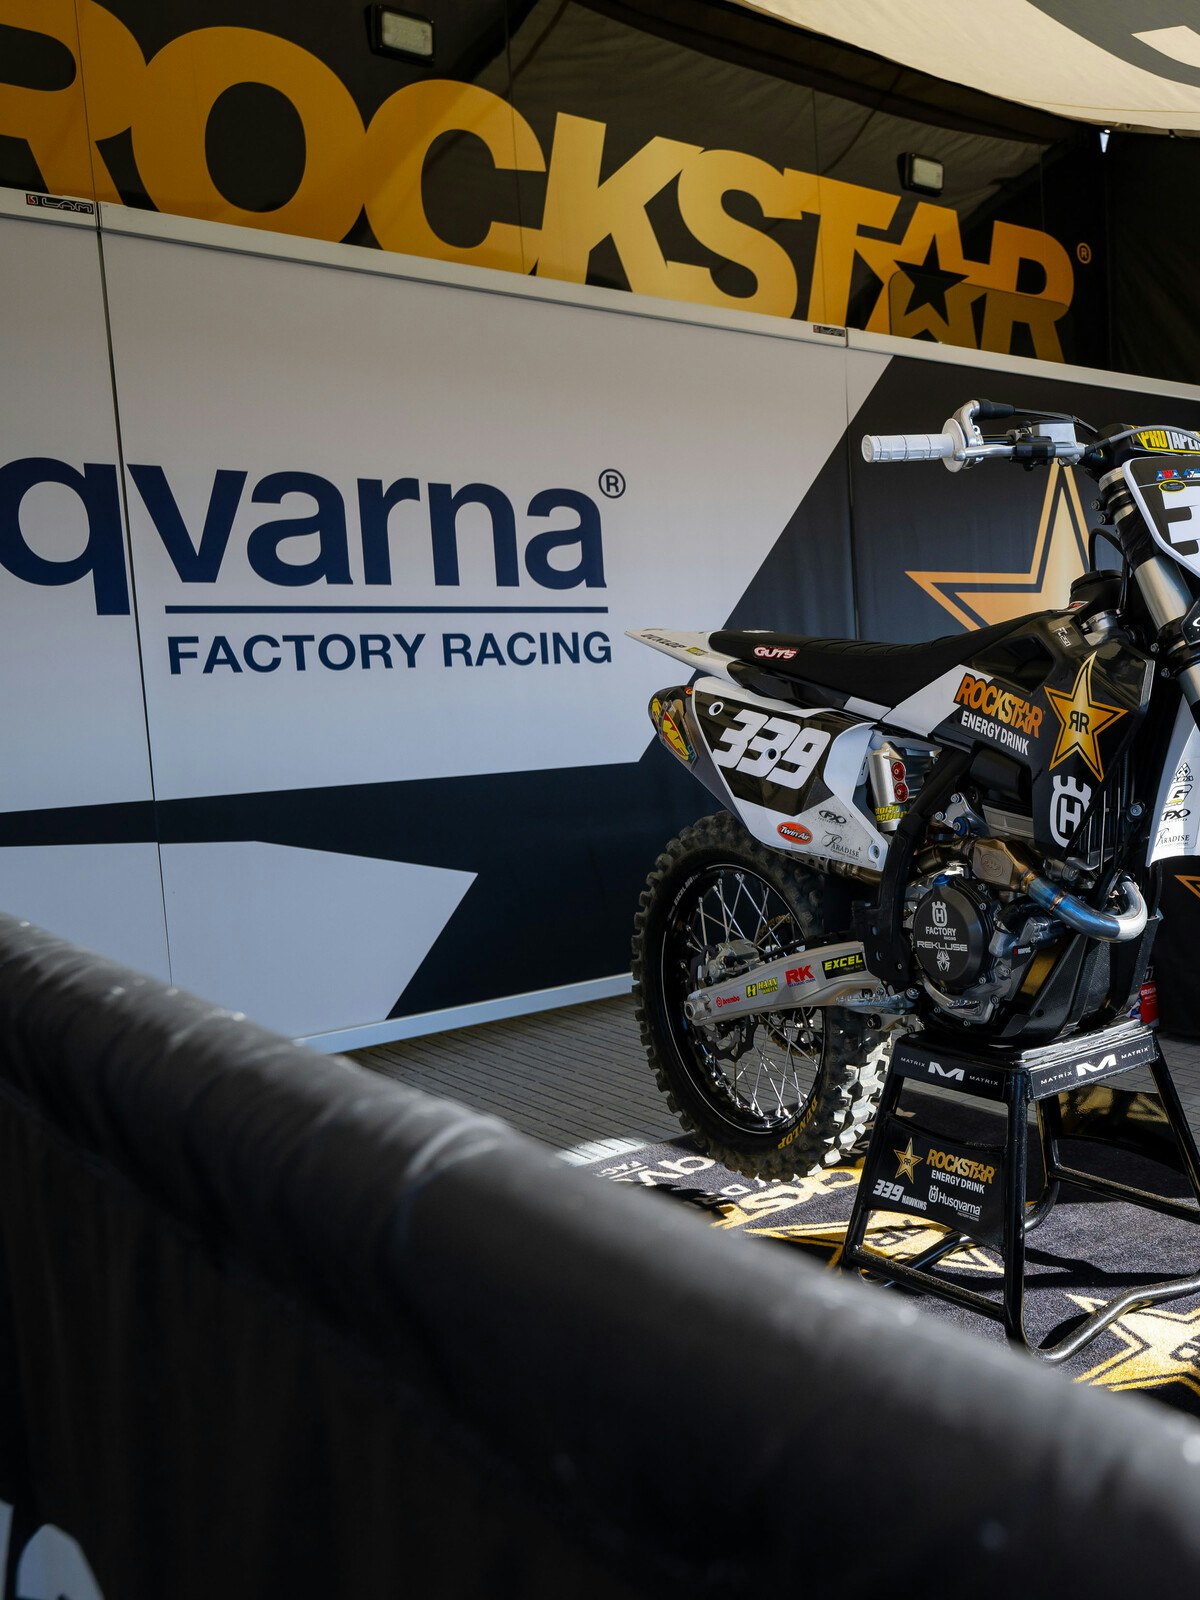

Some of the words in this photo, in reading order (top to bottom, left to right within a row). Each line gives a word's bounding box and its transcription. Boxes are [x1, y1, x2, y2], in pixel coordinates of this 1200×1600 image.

[0, 0, 1076, 363] ROCKSTAR
[0, 456, 607, 615] qvarna
[169, 633, 426, 674] FACTORY
[442, 631, 612, 668] RACING
[753, 646, 798, 659] GUTS
[954, 673, 1043, 738] ROCKSTAR
[961, 711, 1001, 742] ENERGY
[1000, 729, 1030, 756] DRINK
[712, 709, 831, 789] 339
[780, 825, 799, 838] Twin
[797, 832, 810, 841] Air
[925, 926, 957, 936] FACTORY
[916, 941, 968, 952] REKLUSE
[785, 965, 815, 985] RK
[824, 955, 863, 971] EXCEL
[758, 977, 778, 990] HAAN
[900, 1056, 926, 1068] MATRIX
[969, 1075, 999, 1086] MATRIX
[1040, 1070, 1073, 1085] MATRIX
[1121, 1046, 1149, 1060] MATRIX
[926, 1148, 996, 1185] ROCKSTAR
[872, 1179, 905, 1202] 339
[901, 1195, 928, 1211] HAWKINS
[931, 1169, 961, 1187] ENERGY
[961, 1178, 985, 1195] DRINK
[938, 1191, 981, 1216] Husqvarna
